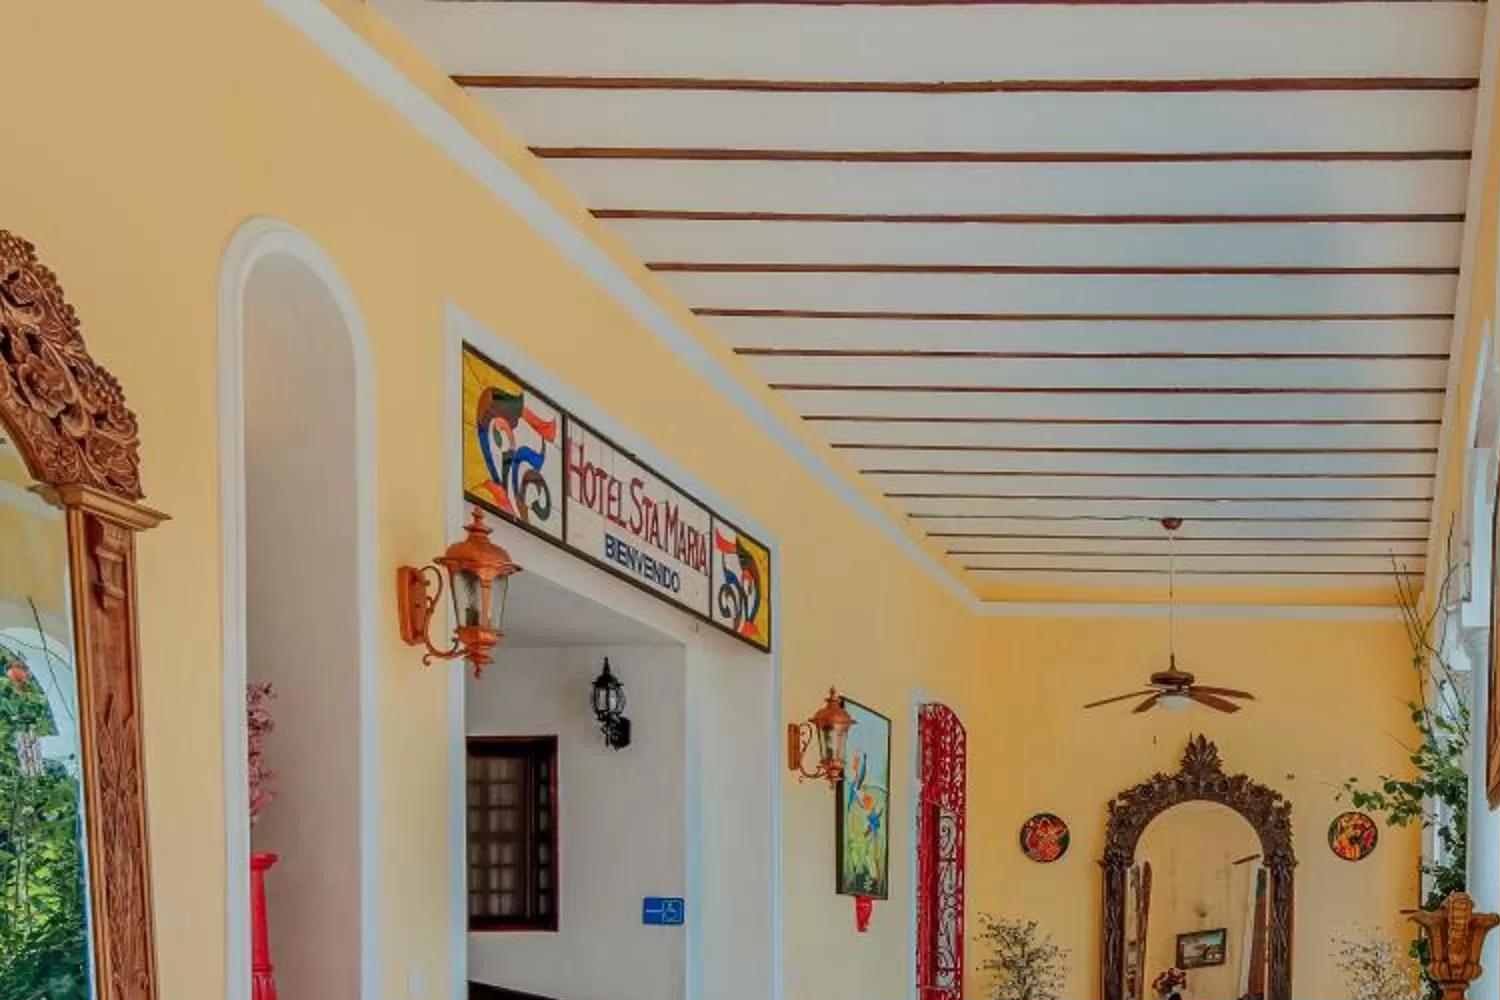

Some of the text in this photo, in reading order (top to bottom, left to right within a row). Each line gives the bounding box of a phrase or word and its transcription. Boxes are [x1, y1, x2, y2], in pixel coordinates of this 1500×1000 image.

[566, 438, 708, 576] HOTEL STA MARIA
[605, 533, 681, 592] BIENVENIDO
